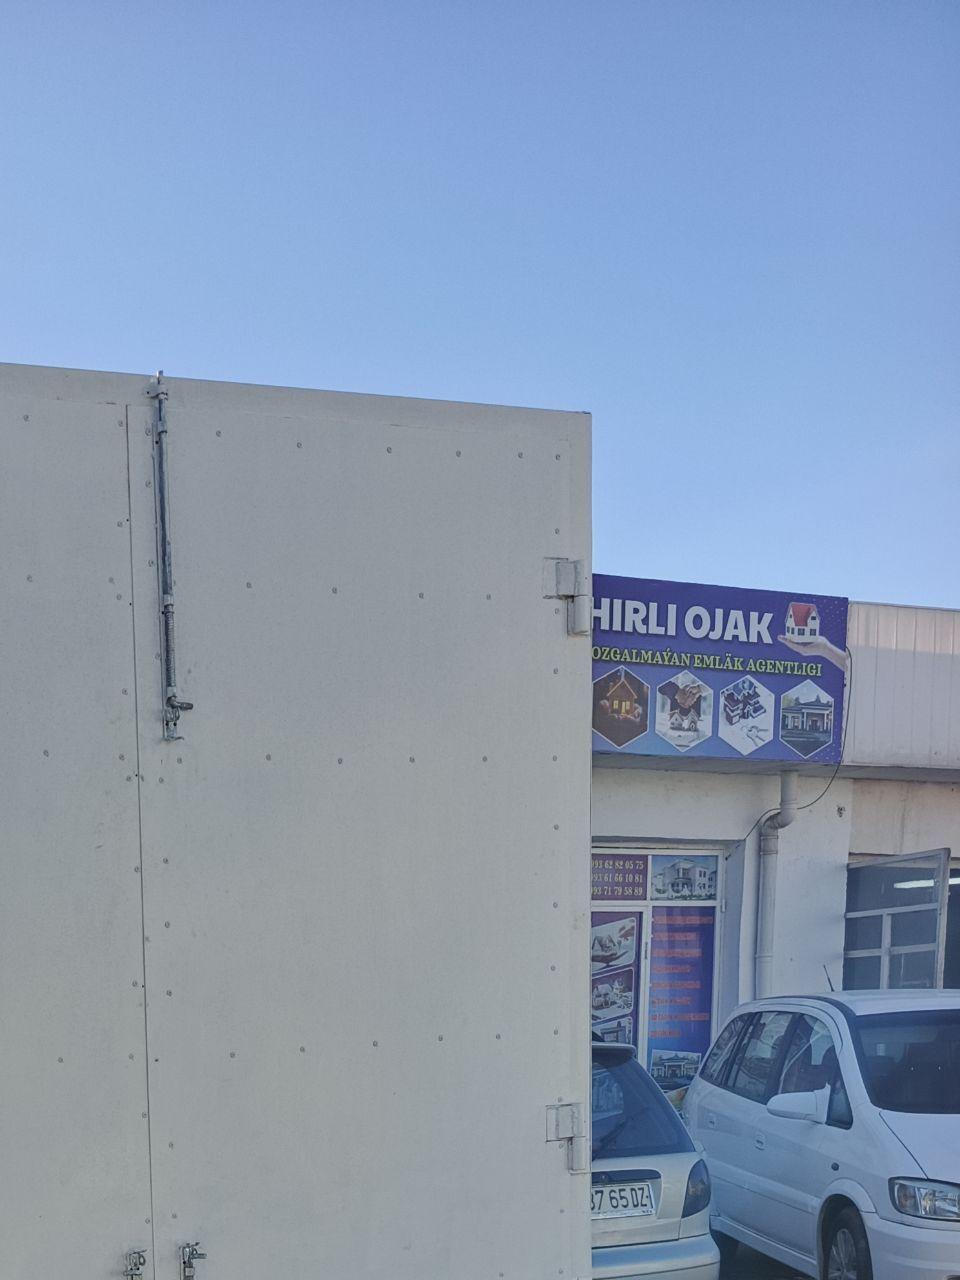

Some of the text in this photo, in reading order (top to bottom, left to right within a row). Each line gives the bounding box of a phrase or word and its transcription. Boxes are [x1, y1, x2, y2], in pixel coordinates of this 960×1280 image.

[591, 597, 773, 644] HIRLI OJAK
[693, 653, 744, 671] EMLÄK
[746, 659, 822, 676] AGENTLIGI
[635, 860, 644, 870] 75
[608, 1188, 629, 1209] 65
[630, 1186, 648, 1208] DZ
